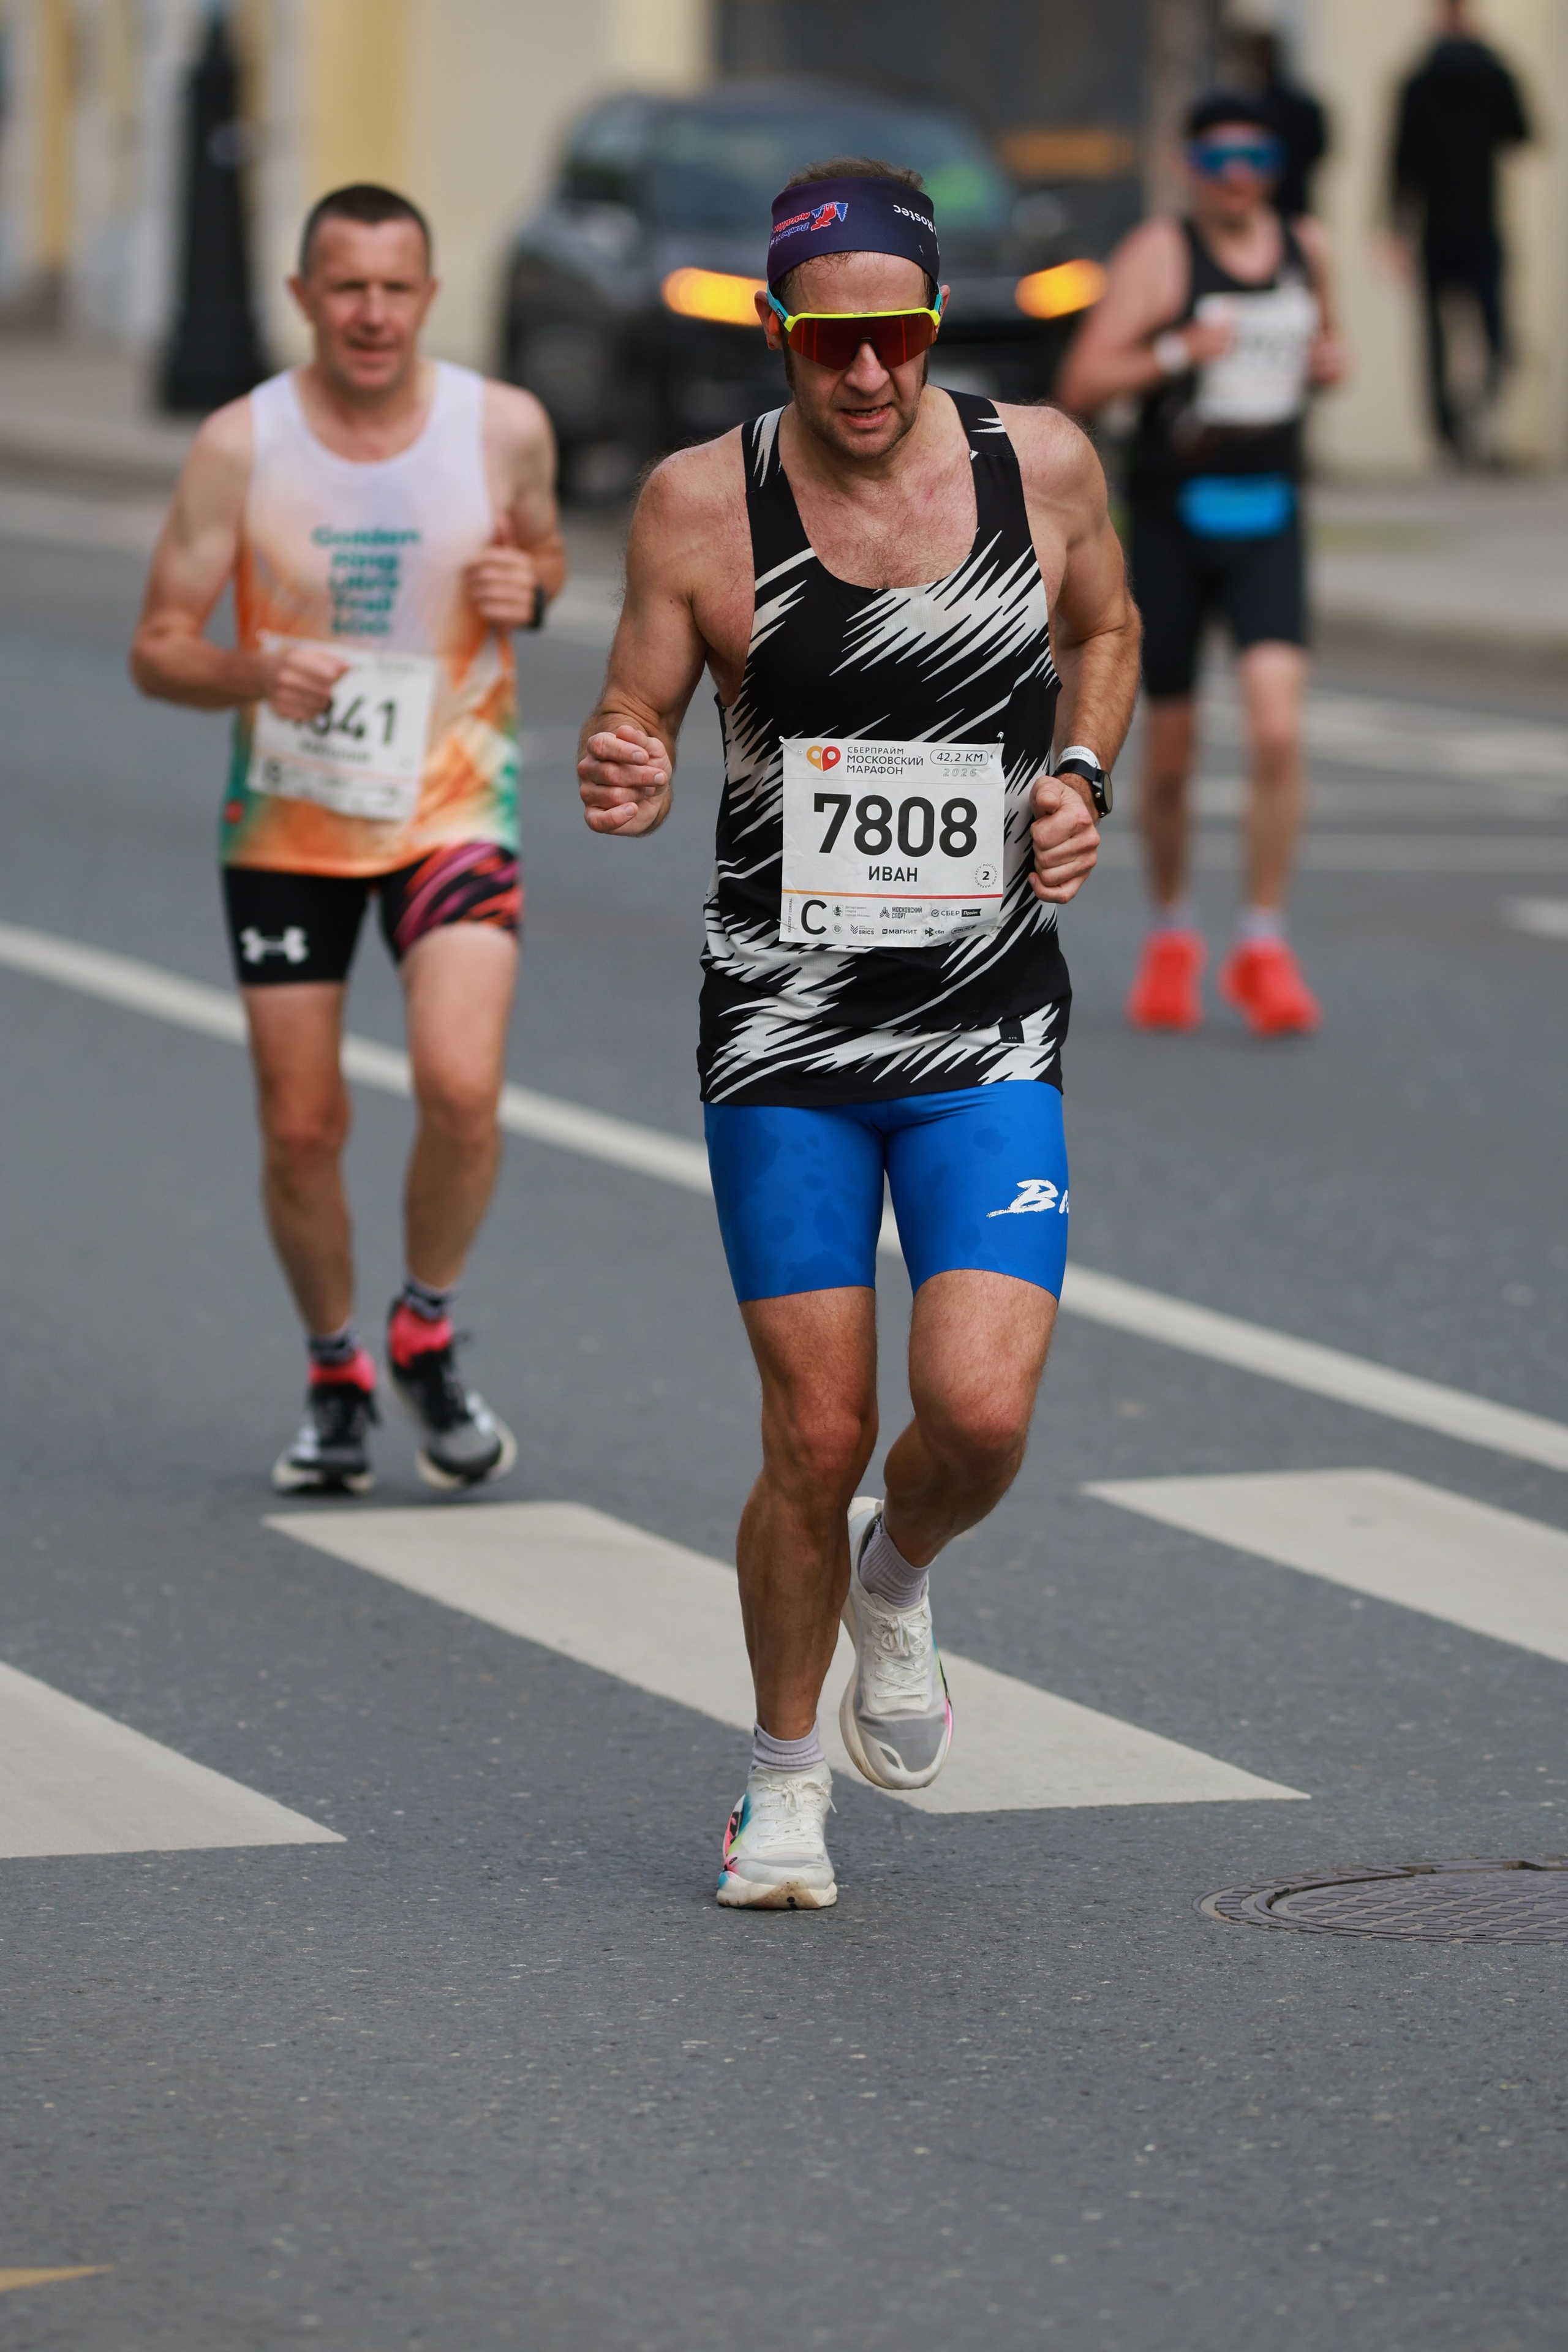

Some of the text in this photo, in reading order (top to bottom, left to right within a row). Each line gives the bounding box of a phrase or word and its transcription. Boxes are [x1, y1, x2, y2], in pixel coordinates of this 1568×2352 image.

[893, 204, 934, 233] Rostec
[847, 746, 904, 755] СБЕРПРАЙМ
[846, 755, 924, 766] МОСКОВСКИЙ
[937, 752, 983, 763] 42,2 КМ
[846, 765, 903, 775] МАРАФОН
[943, 768, 977, 777] 2026
[813, 793, 978, 858] 7808
[868, 865, 918, 882] ИВАН
[982, 871, 990, 880] 2
